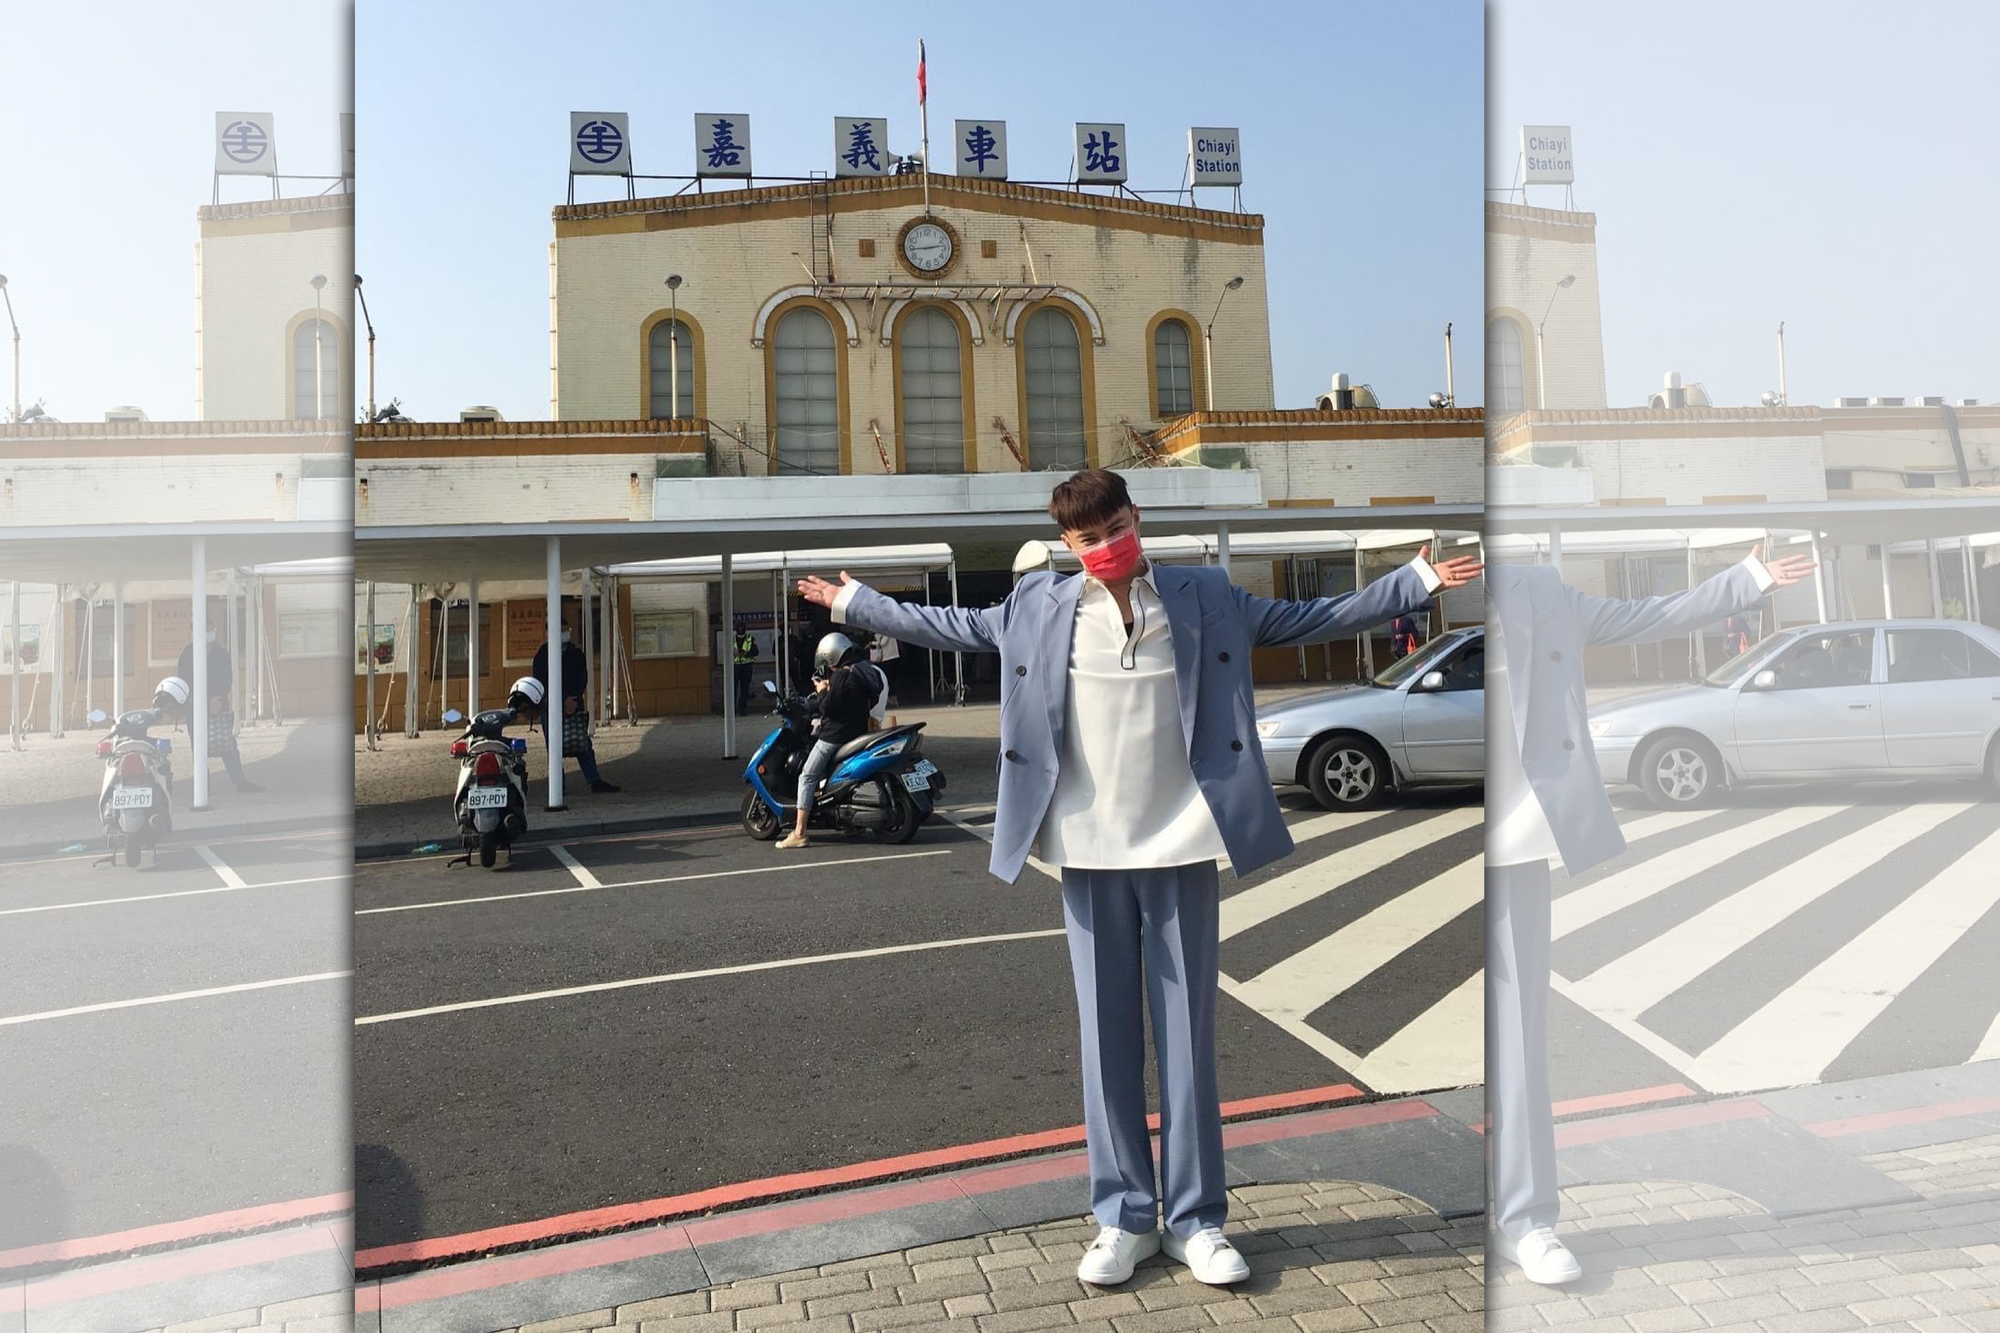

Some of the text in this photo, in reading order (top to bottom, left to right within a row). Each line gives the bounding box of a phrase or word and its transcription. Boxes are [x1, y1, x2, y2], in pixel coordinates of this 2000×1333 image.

[1197, 138, 1235, 156] Chiayi
[1529, 136, 1567, 154] Chiayi
[1196, 158, 1240, 173] Station
[1528, 156, 1572, 171] Station
[923, 229, 931, 237] 12
[941, 244, 946, 252] 3
[912, 252, 917, 260] 8
[918, 258, 924, 266] 7
[926, 260, 931, 268] 6
[934, 258, 940, 266] 5
